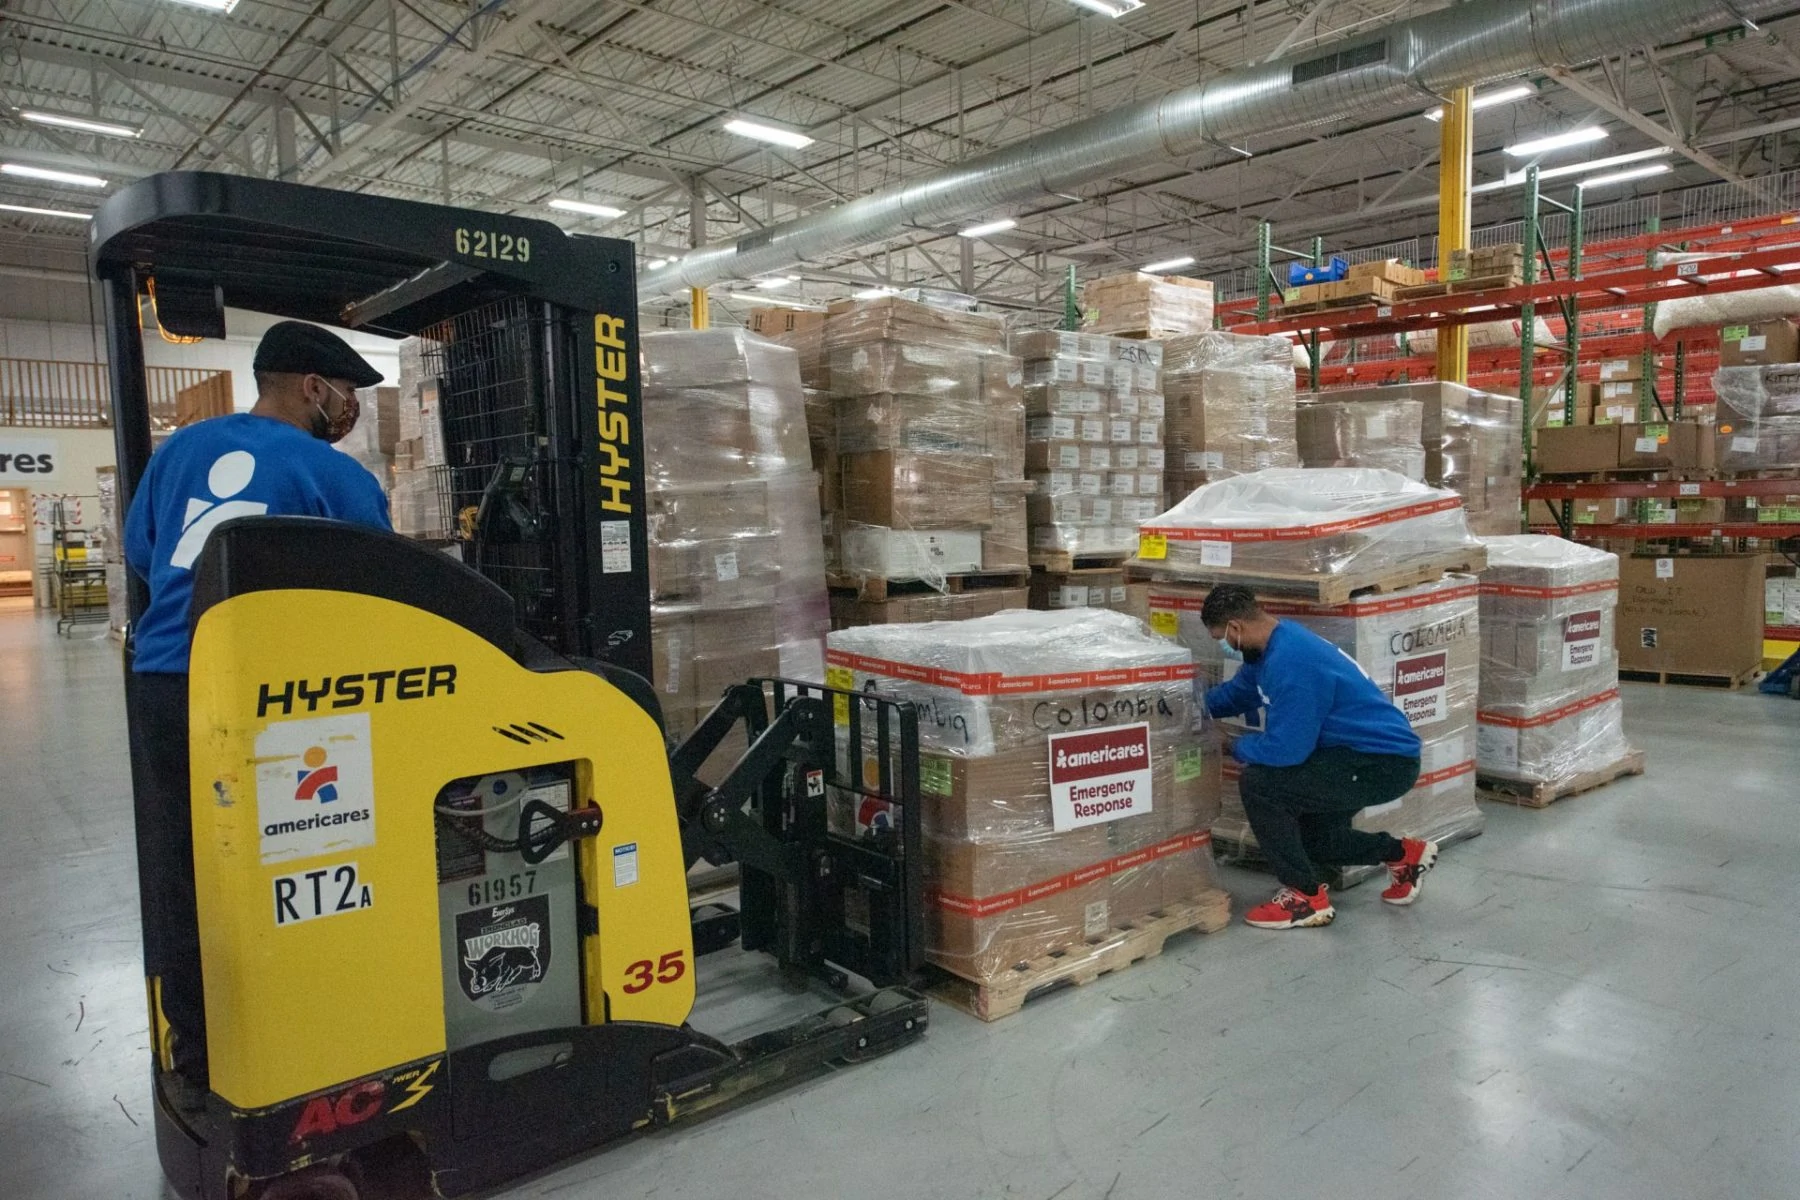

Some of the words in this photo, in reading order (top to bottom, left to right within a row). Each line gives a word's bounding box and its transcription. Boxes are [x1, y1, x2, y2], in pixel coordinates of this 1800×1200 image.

[455, 227, 531, 263] 62129
[594, 312, 632, 514] HYSTER
[256, 663, 458, 718] HYSTER
[1404, 665, 1444, 685] americares
[1033, 694, 1173, 730] Colombia
[1403, 693, 1438, 711] Emergency
[1067, 743, 1145, 768] americares
[1069, 779, 1136, 802] Emergency
[1074, 796, 1133, 819] Response
[264, 808, 370, 837] americares
[468, 869, 537, 907] 61957
[464, 922, 541, 960] WORKHOG
[622, 949, 686, 995] 35
